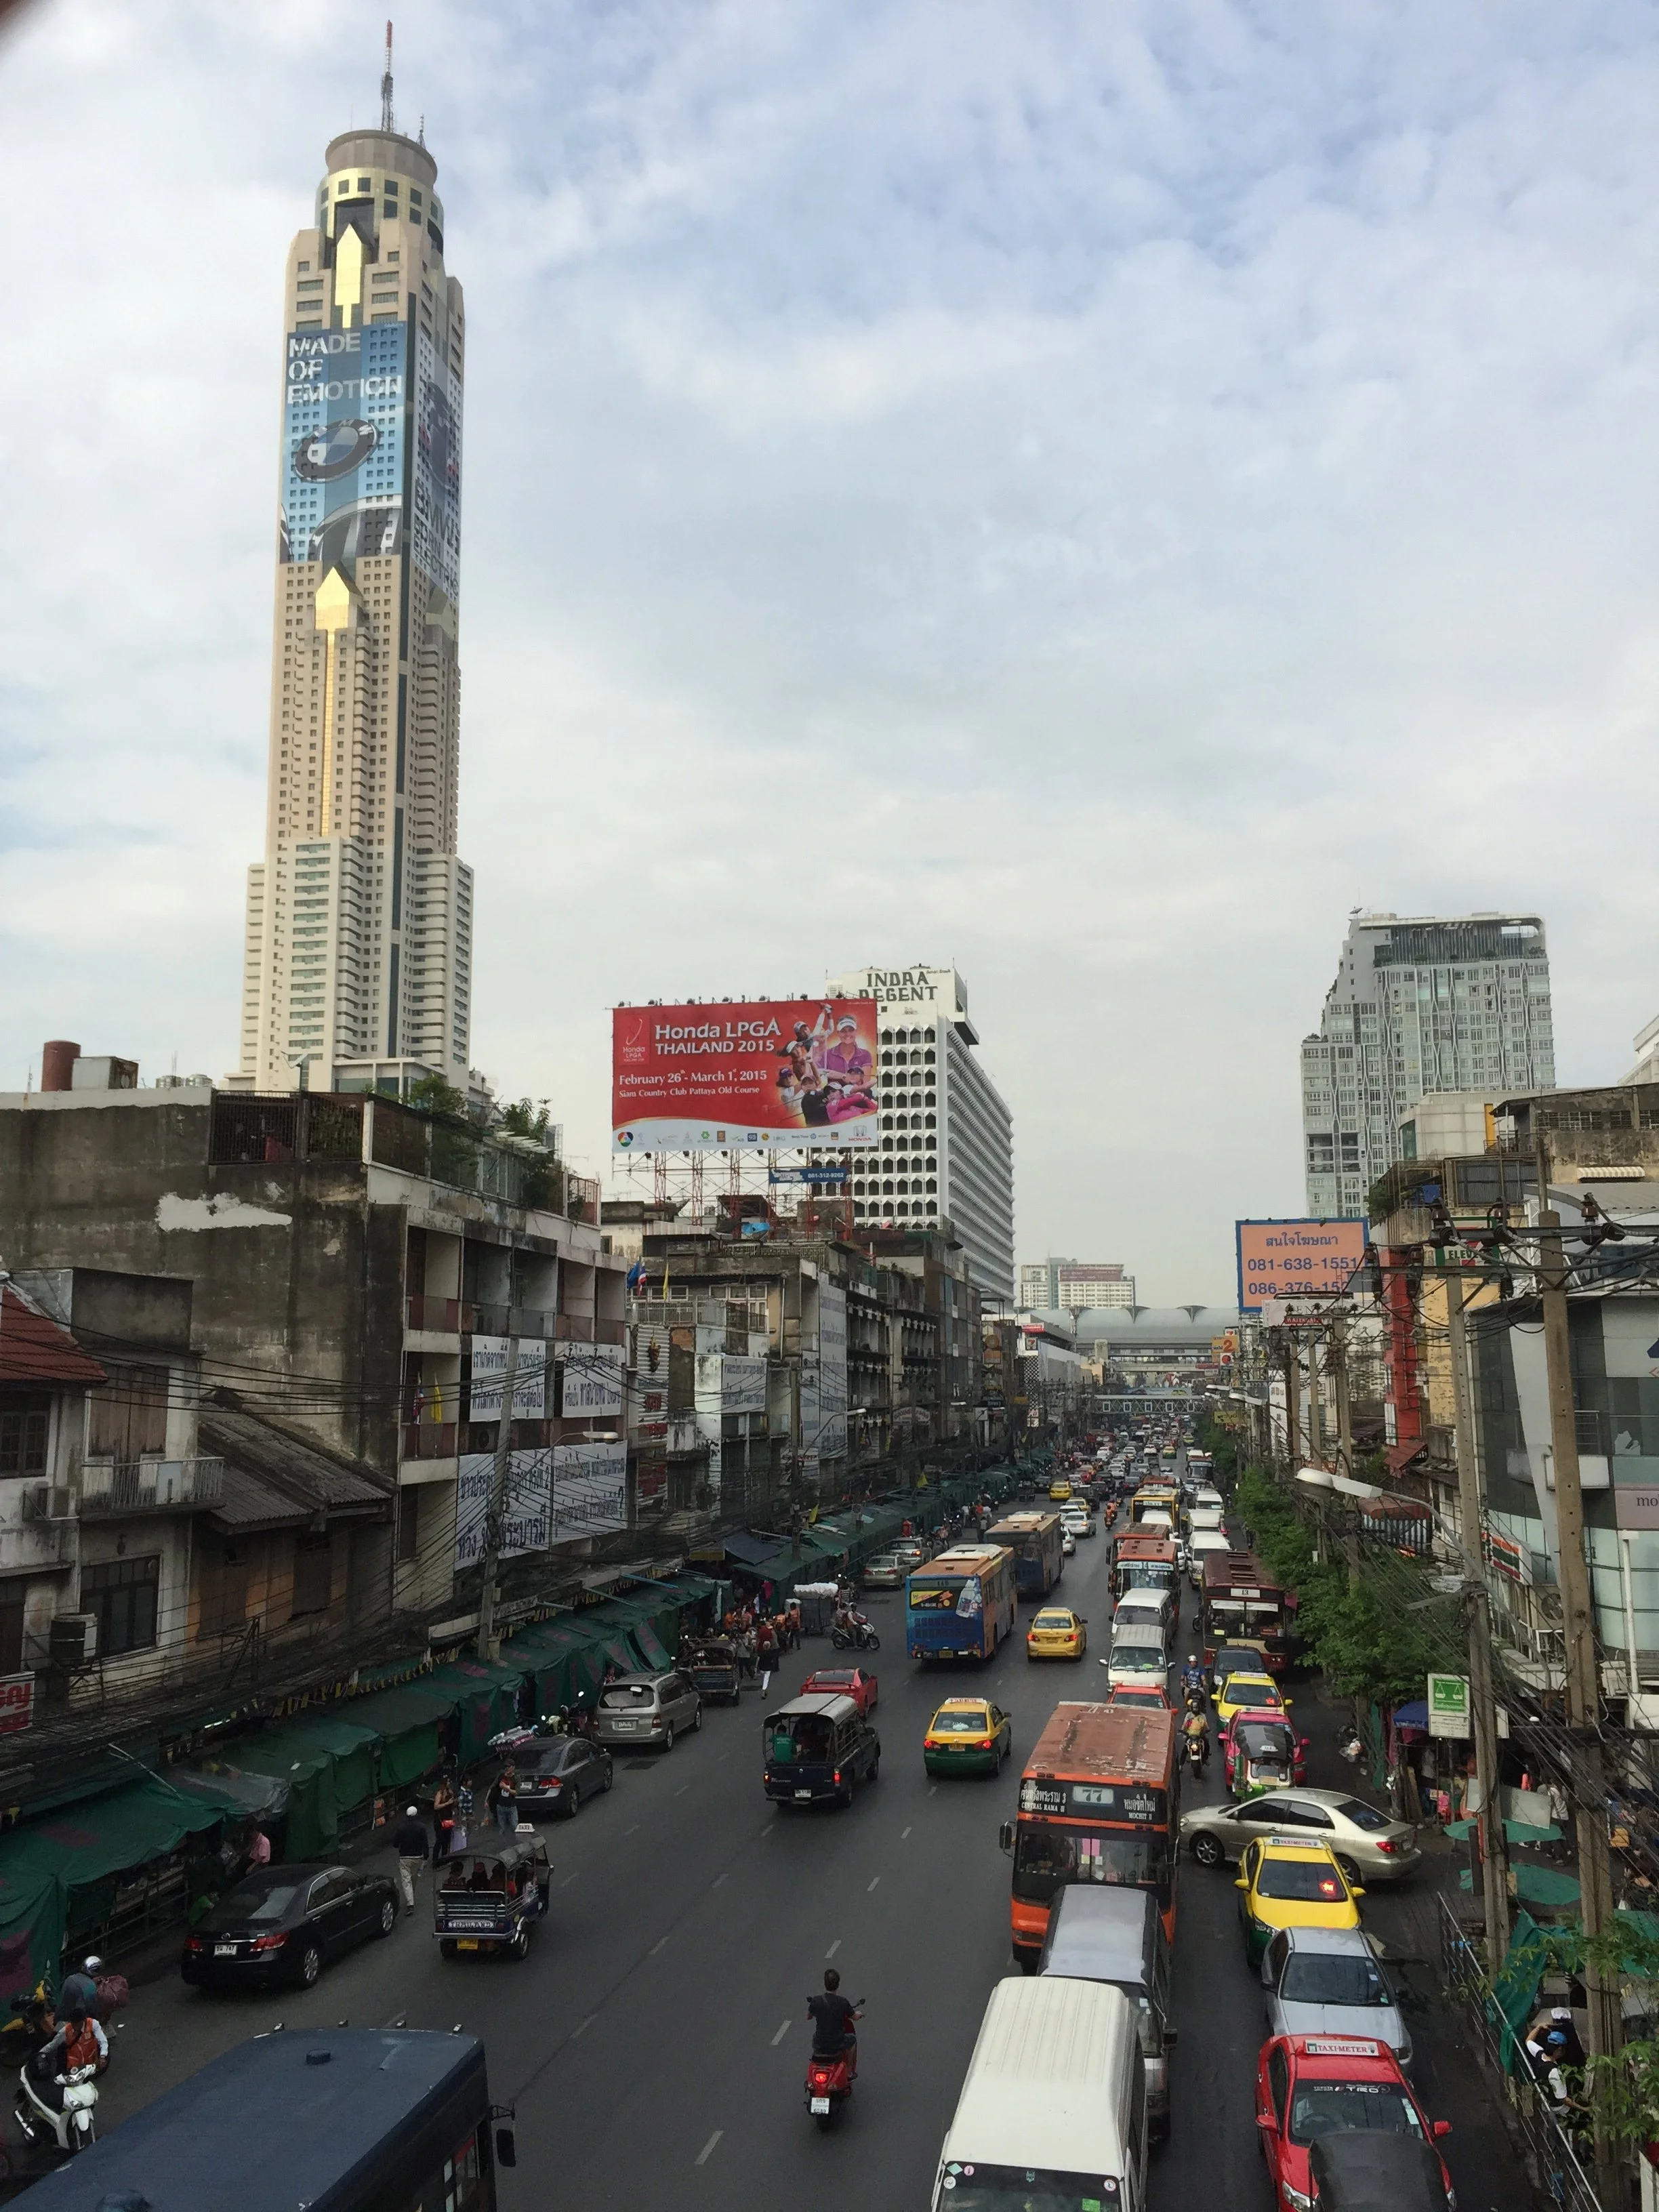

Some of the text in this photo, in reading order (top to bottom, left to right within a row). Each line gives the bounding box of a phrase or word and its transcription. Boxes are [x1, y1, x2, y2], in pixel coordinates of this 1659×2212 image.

[289, 332, 361, 357] MADE
[289, 359, 323, 381] OF
[287, 375, 402, 404] EMOTION
[867, 971, 929, 987] INDRA
[655, 1017, 781, 1040] Honda LPGA
[655, 1040, 775, 1054] THAILAND 2015
[619, 1074, 665, 1086] February
[691, 1070, 724, 1082] March
[740, 1070, 767, 1080] 2015
[619, 1090, 636, 1098] Siam
[638, 1089, 667, 1098] Country
[670, 1088, 687, 1096] Club
[690, 1087, 716, 1096] Pattaya
[735, 1086, 760, 1094] Course
[1266, 1231, 1338, 1247] สนใจโฆษณา
[1448, 1250, 1478, 1259] ELEV
[1248, 1257, 1357, 1271] 081-638-1551
[1637, 1494, 1659, 1507] mo
[1063, 1793, 1066, 1803] 3
[1082, 1788, 1103, 1802] 77
